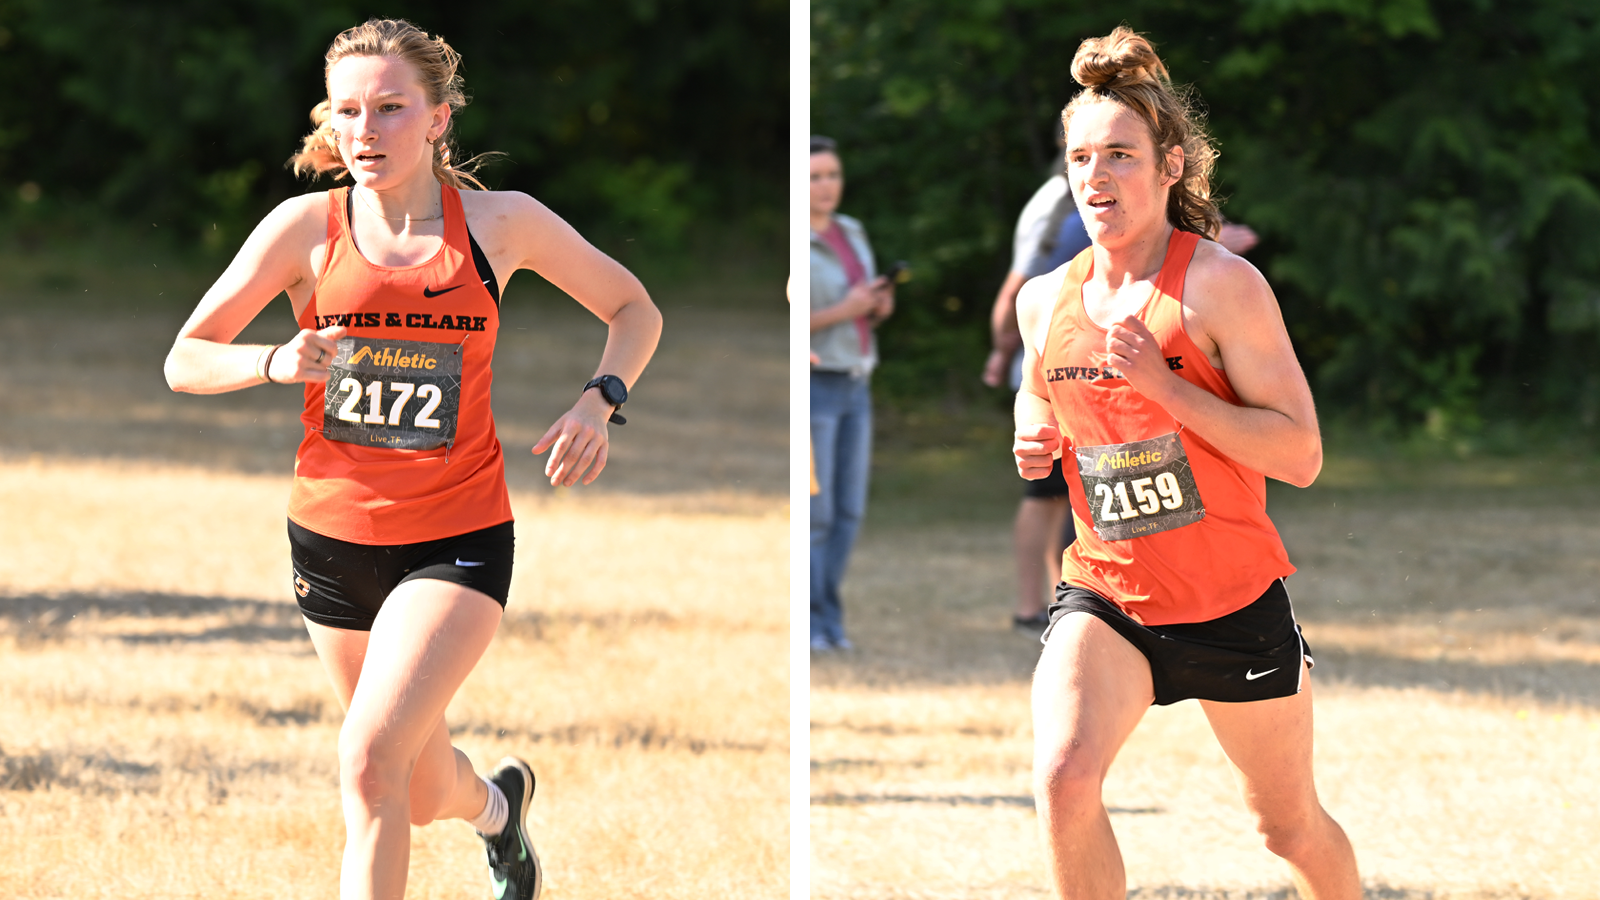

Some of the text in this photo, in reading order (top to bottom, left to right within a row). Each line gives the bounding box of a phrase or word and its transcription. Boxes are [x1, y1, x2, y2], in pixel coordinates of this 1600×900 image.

[314, 312, 488, 331] LEWIS & CLARK
[347, 345, 437, 370] Athletic
[1046, 366, 1099, 382] LEWIS
[338, 377, 442, 429] 2172
[1095, 450, 1162, 472] Athletic
[1094, 472, 1184, 522] 2159
